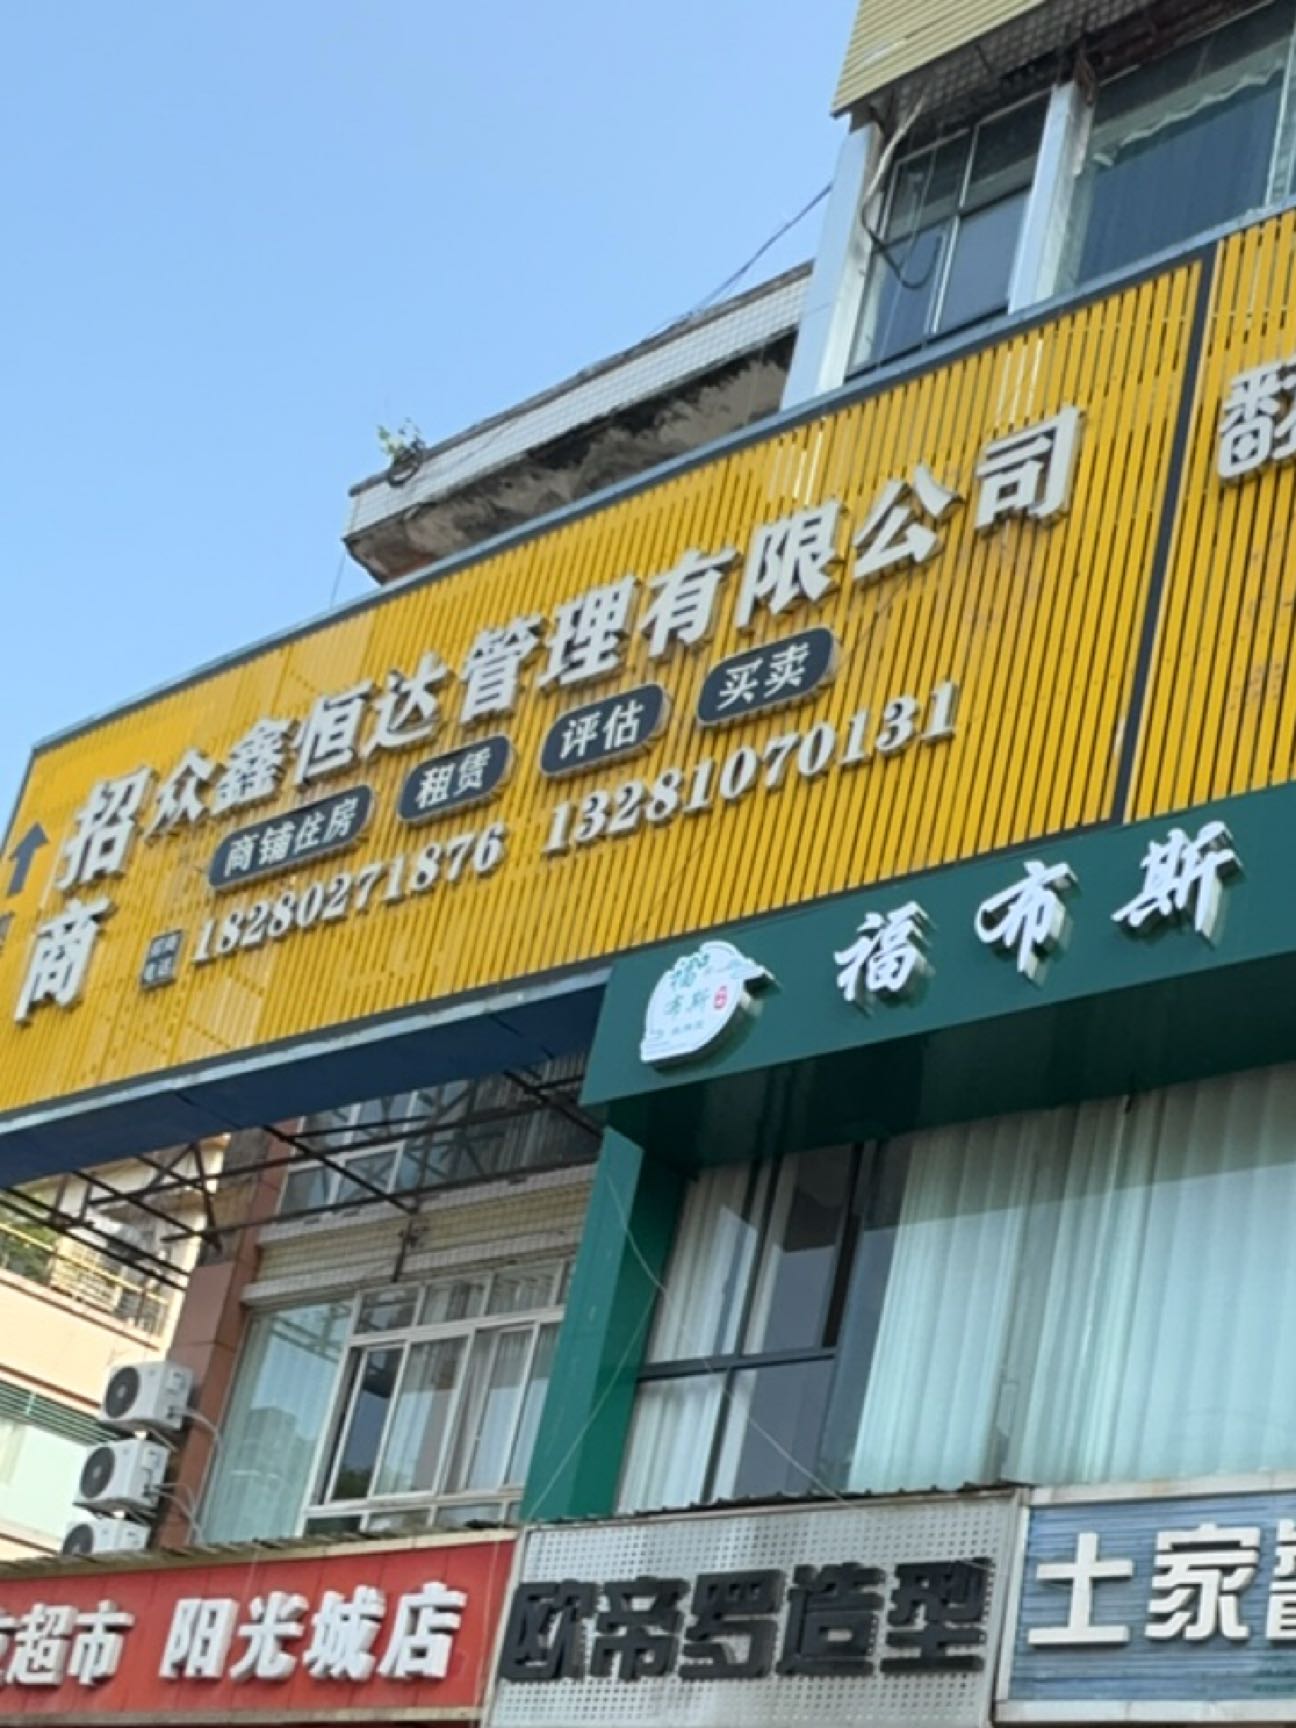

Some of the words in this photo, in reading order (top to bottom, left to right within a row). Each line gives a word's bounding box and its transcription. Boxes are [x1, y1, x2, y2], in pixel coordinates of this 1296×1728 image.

[142, 405, 1083, 840] 众鑫恒达管理有限公司
[716, 644, 811, 710] 买卖
[559, 700, 644, 761] 评估
[192, 820, 507, 966] 18280271876
[542, 681, 958, 855] 13281070131
[415, 746, 492, 810] 租赁
[222, 797, 360, 878] 商铺住房
[833, 819, 1242, 1006] 福布斯
[159, 1580, 467, 1682] 阳光城店
